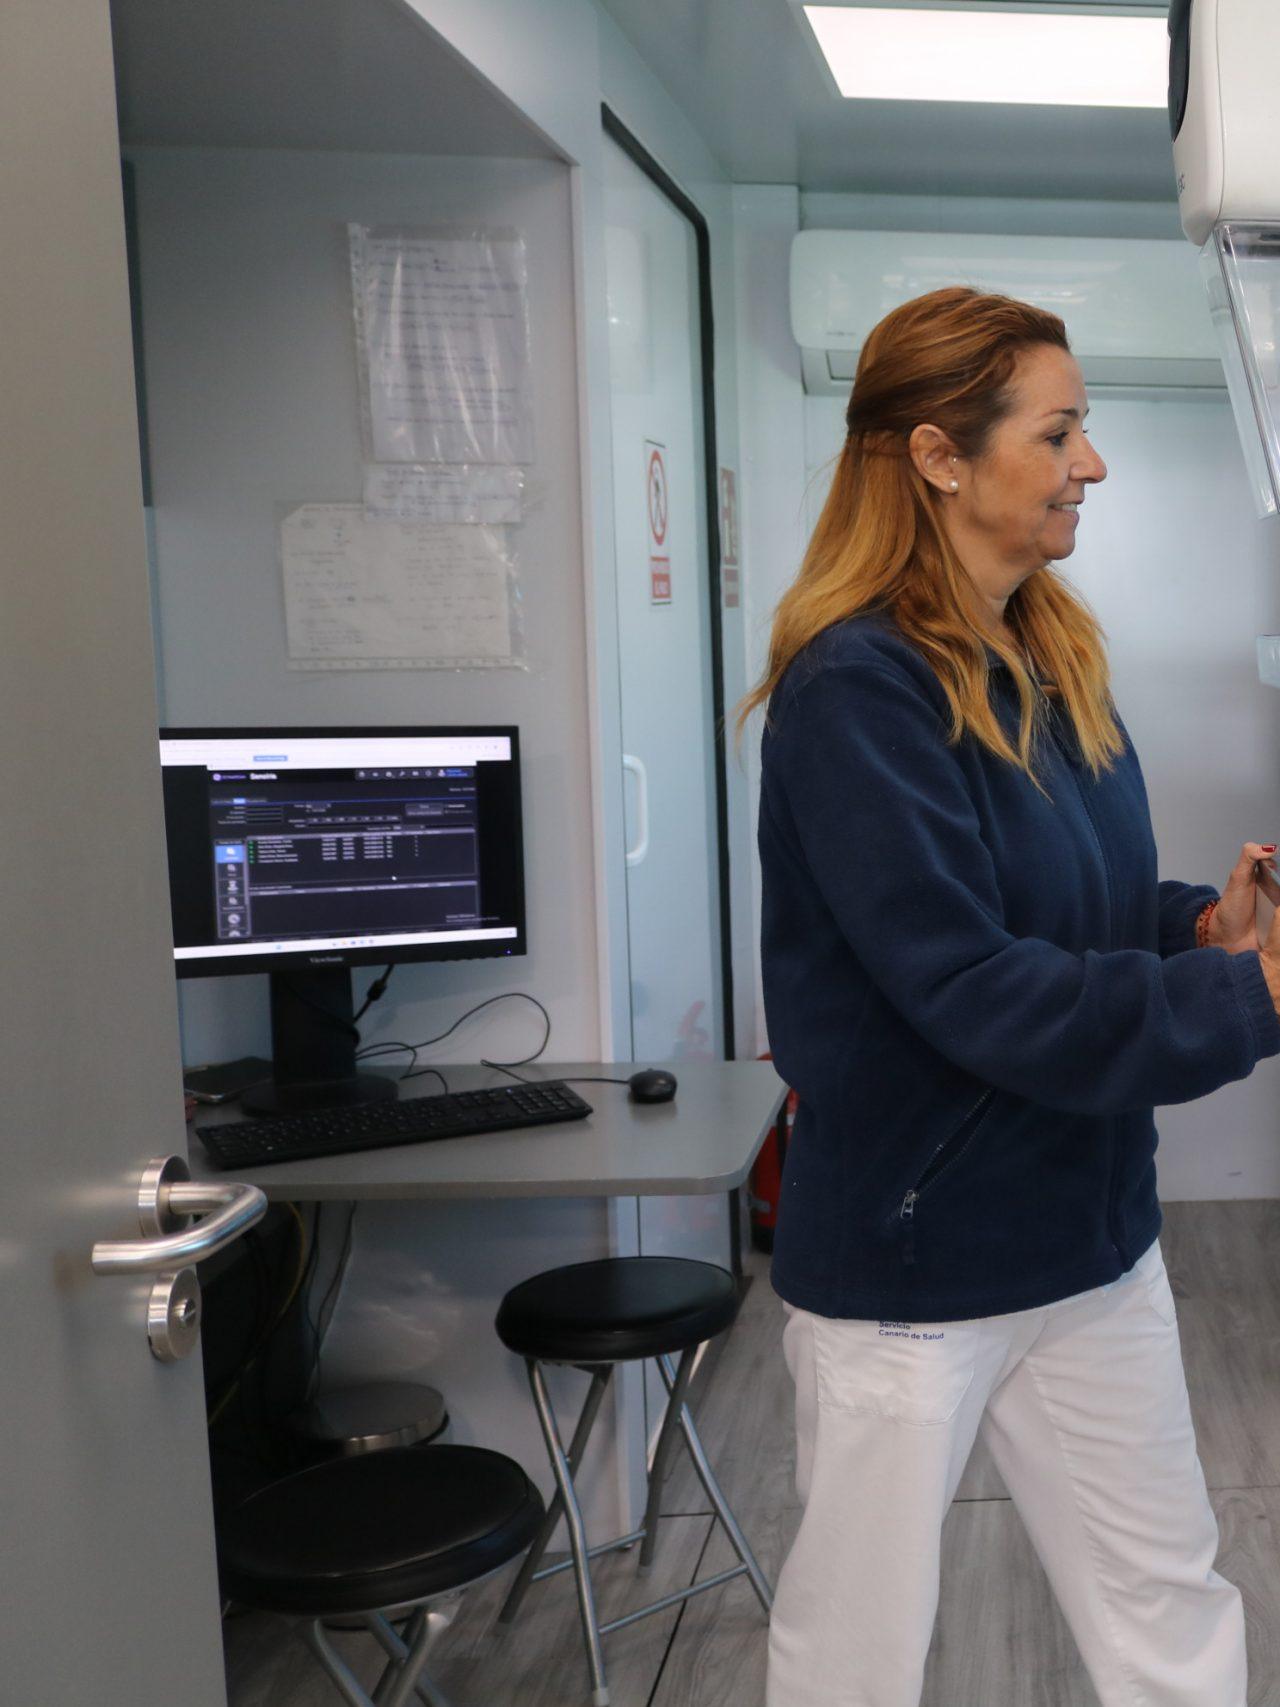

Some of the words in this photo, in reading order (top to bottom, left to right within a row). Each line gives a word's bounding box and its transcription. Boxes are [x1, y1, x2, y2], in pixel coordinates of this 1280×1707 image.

[879, 1321, 911, 1329] Servicio
[879, 1329, 909, 1338] Canario
[923, 1332, 944, 1340] Salud
